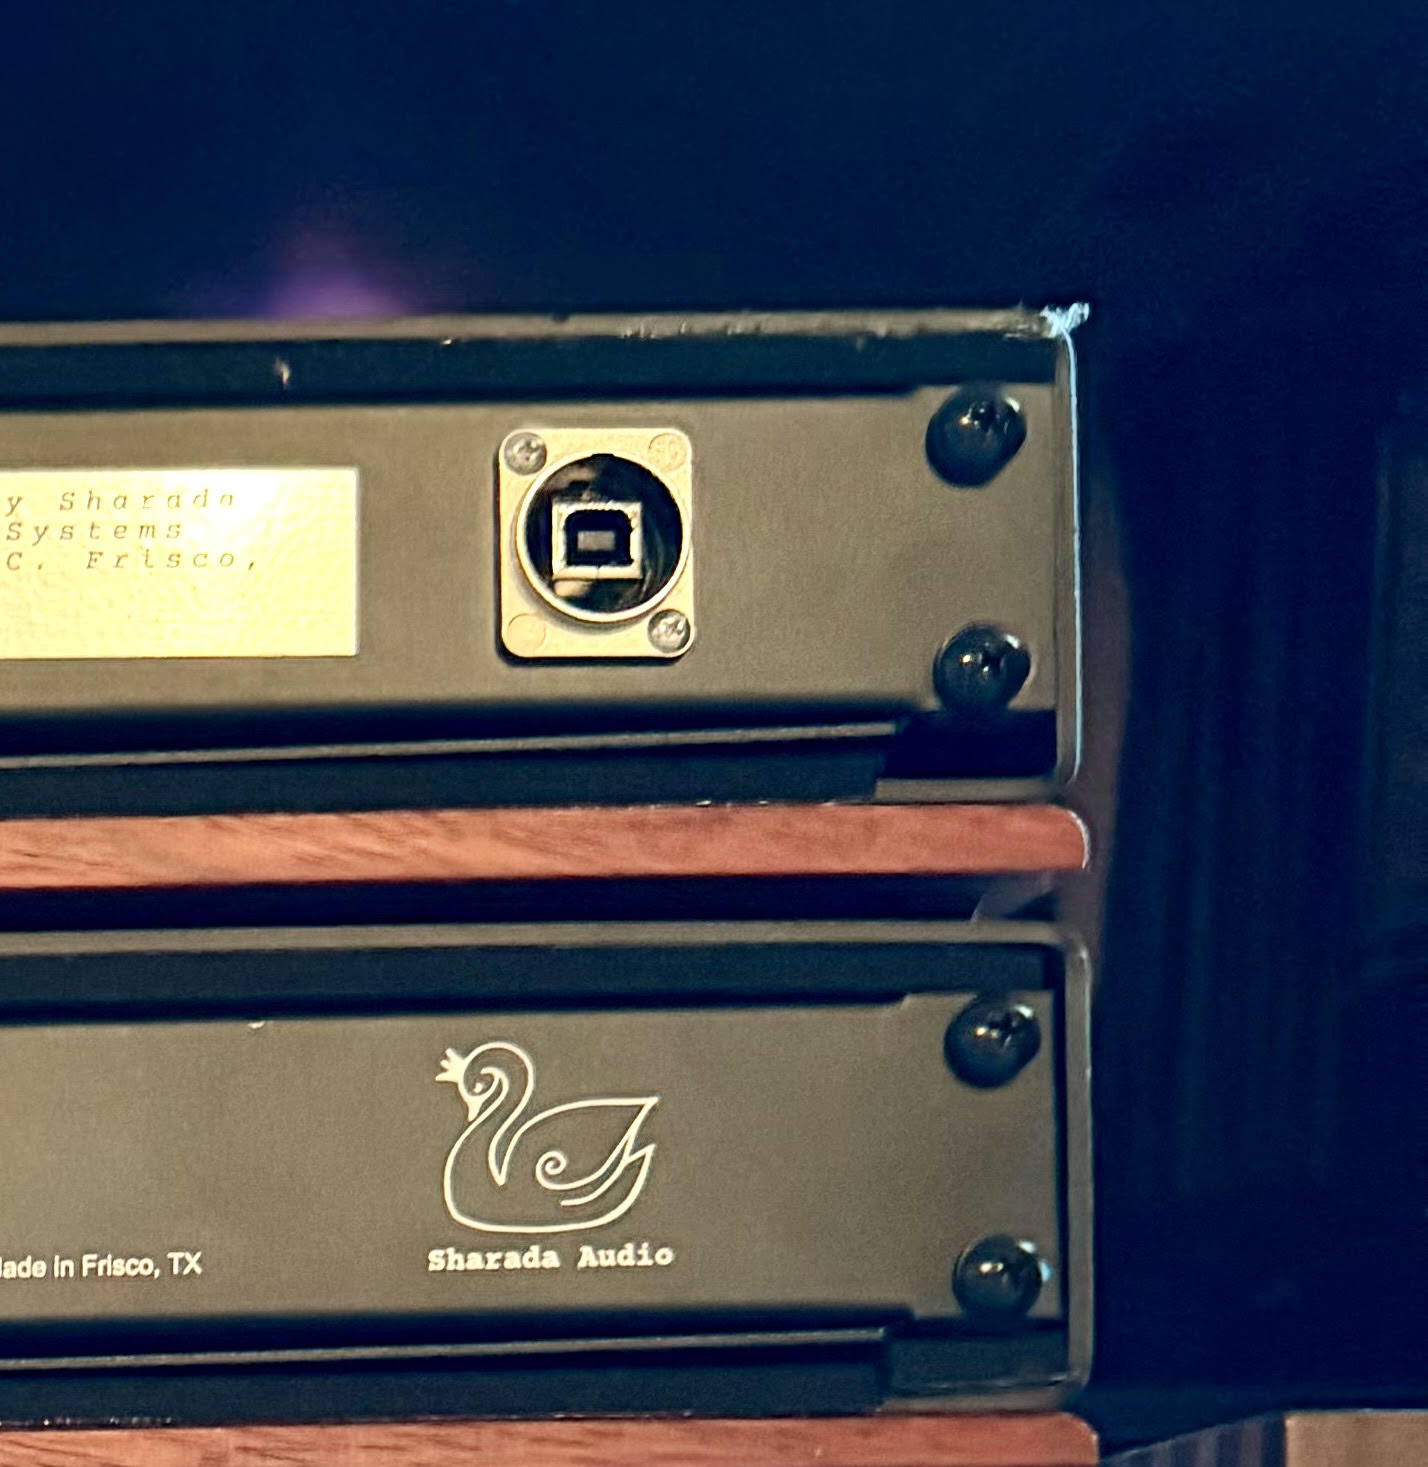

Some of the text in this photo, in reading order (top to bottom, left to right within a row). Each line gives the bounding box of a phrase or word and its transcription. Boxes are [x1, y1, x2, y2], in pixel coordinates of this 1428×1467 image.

[60, 489, 236, 512] Sharada
[7, 522, 183, 546] Systems
[53, 1256, 75, 1278] in
[82, 1253, 161, 1280] Frisco,
[167, 1252, 203, 1275] TX
[428, 1244, 674, 1271] Sharada Audio
